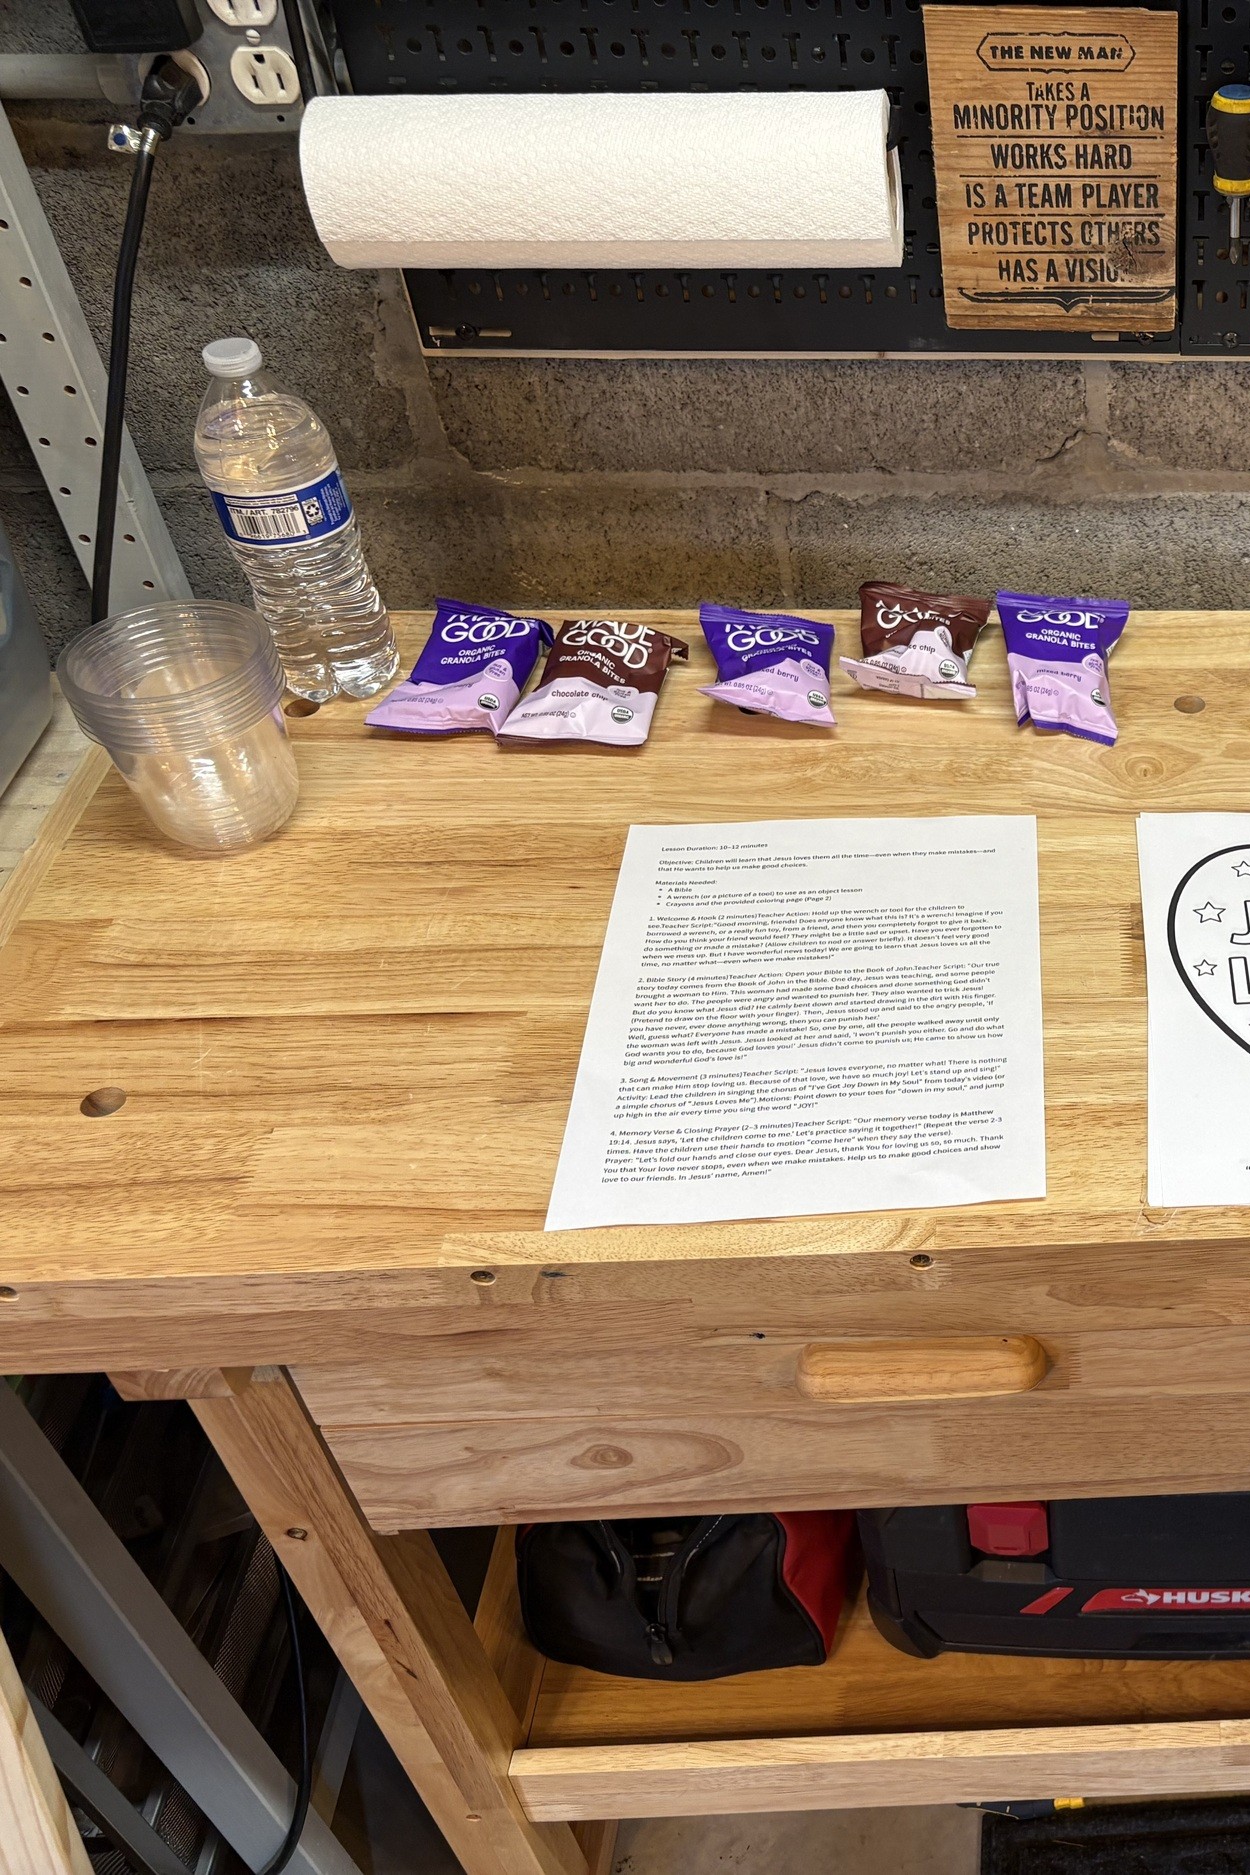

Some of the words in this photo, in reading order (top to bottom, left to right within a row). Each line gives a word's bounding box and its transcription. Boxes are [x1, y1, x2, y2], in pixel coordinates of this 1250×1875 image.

[990, 45, 1024, 60] THE
[1030, 45, 1072, 60] NEW
[1078, 45, 1123, 60] MAN
[1026, 81, 1074, 102] TAKES
[1080, 82, 1091, 102] A
[953, 103, 1056, 131] MINORITY
[1066, 104, 1164, 131] POSITION
[990, 143, 1068, 170] WORKS
[1075, 143, 1132, 170] HARD
[965, 183, 986, 209] IS
[995, 183, 1008, 209] A
[1016, 183, 1072, 209] TEAM
[1082, 183, 1160, 209] PLAYER
[967, 221, 1073, 246] PROTECTS
[998, 258, 1039, 284] HAS
[1046, 259, 1058, 283] A
[1065, 258, 1131, 283] VISIO
[441, 620, 530, 642] GOOD
[570, 620, 656, 646] MADE
[1041, 629, 1081, 641] ORGANIC
[562, 628, 648, 669] GOOD
[919, 644, 936, 654] chip
[1026, 632, 1068, 646] GRANOLA
[1070, 641, 1096, 650] BITES
[440, 655, 482, 665] GRANOLA
[483, 648, 506, 660] BITES
[458, 644, 496, 656] ORGANIC
[559, 656, 600, 668] GRANOLA
[602, 666, 626, 684] BITES
[777, 669, 799, 682] berry
[1061, 672, 1082, 682] berry
[552, 690, 589, 698] chocolate
[753, 684, 766, 695] (24g)
[1040, 686, 1053, 696] (24g)
[625, 1111, 643, 1119] high
[739, 1105, 755, 1114] sing
[618, 1128, 652, 1138] Memory
[683, 1126, 713, 1135] Closing
[714, 1124, 740, 1133] Prayer
[826, 1118, 851, 1126] Script:
[929, 1112, 951, 1120] today
[646, 1173, 677, 1182] friends.
